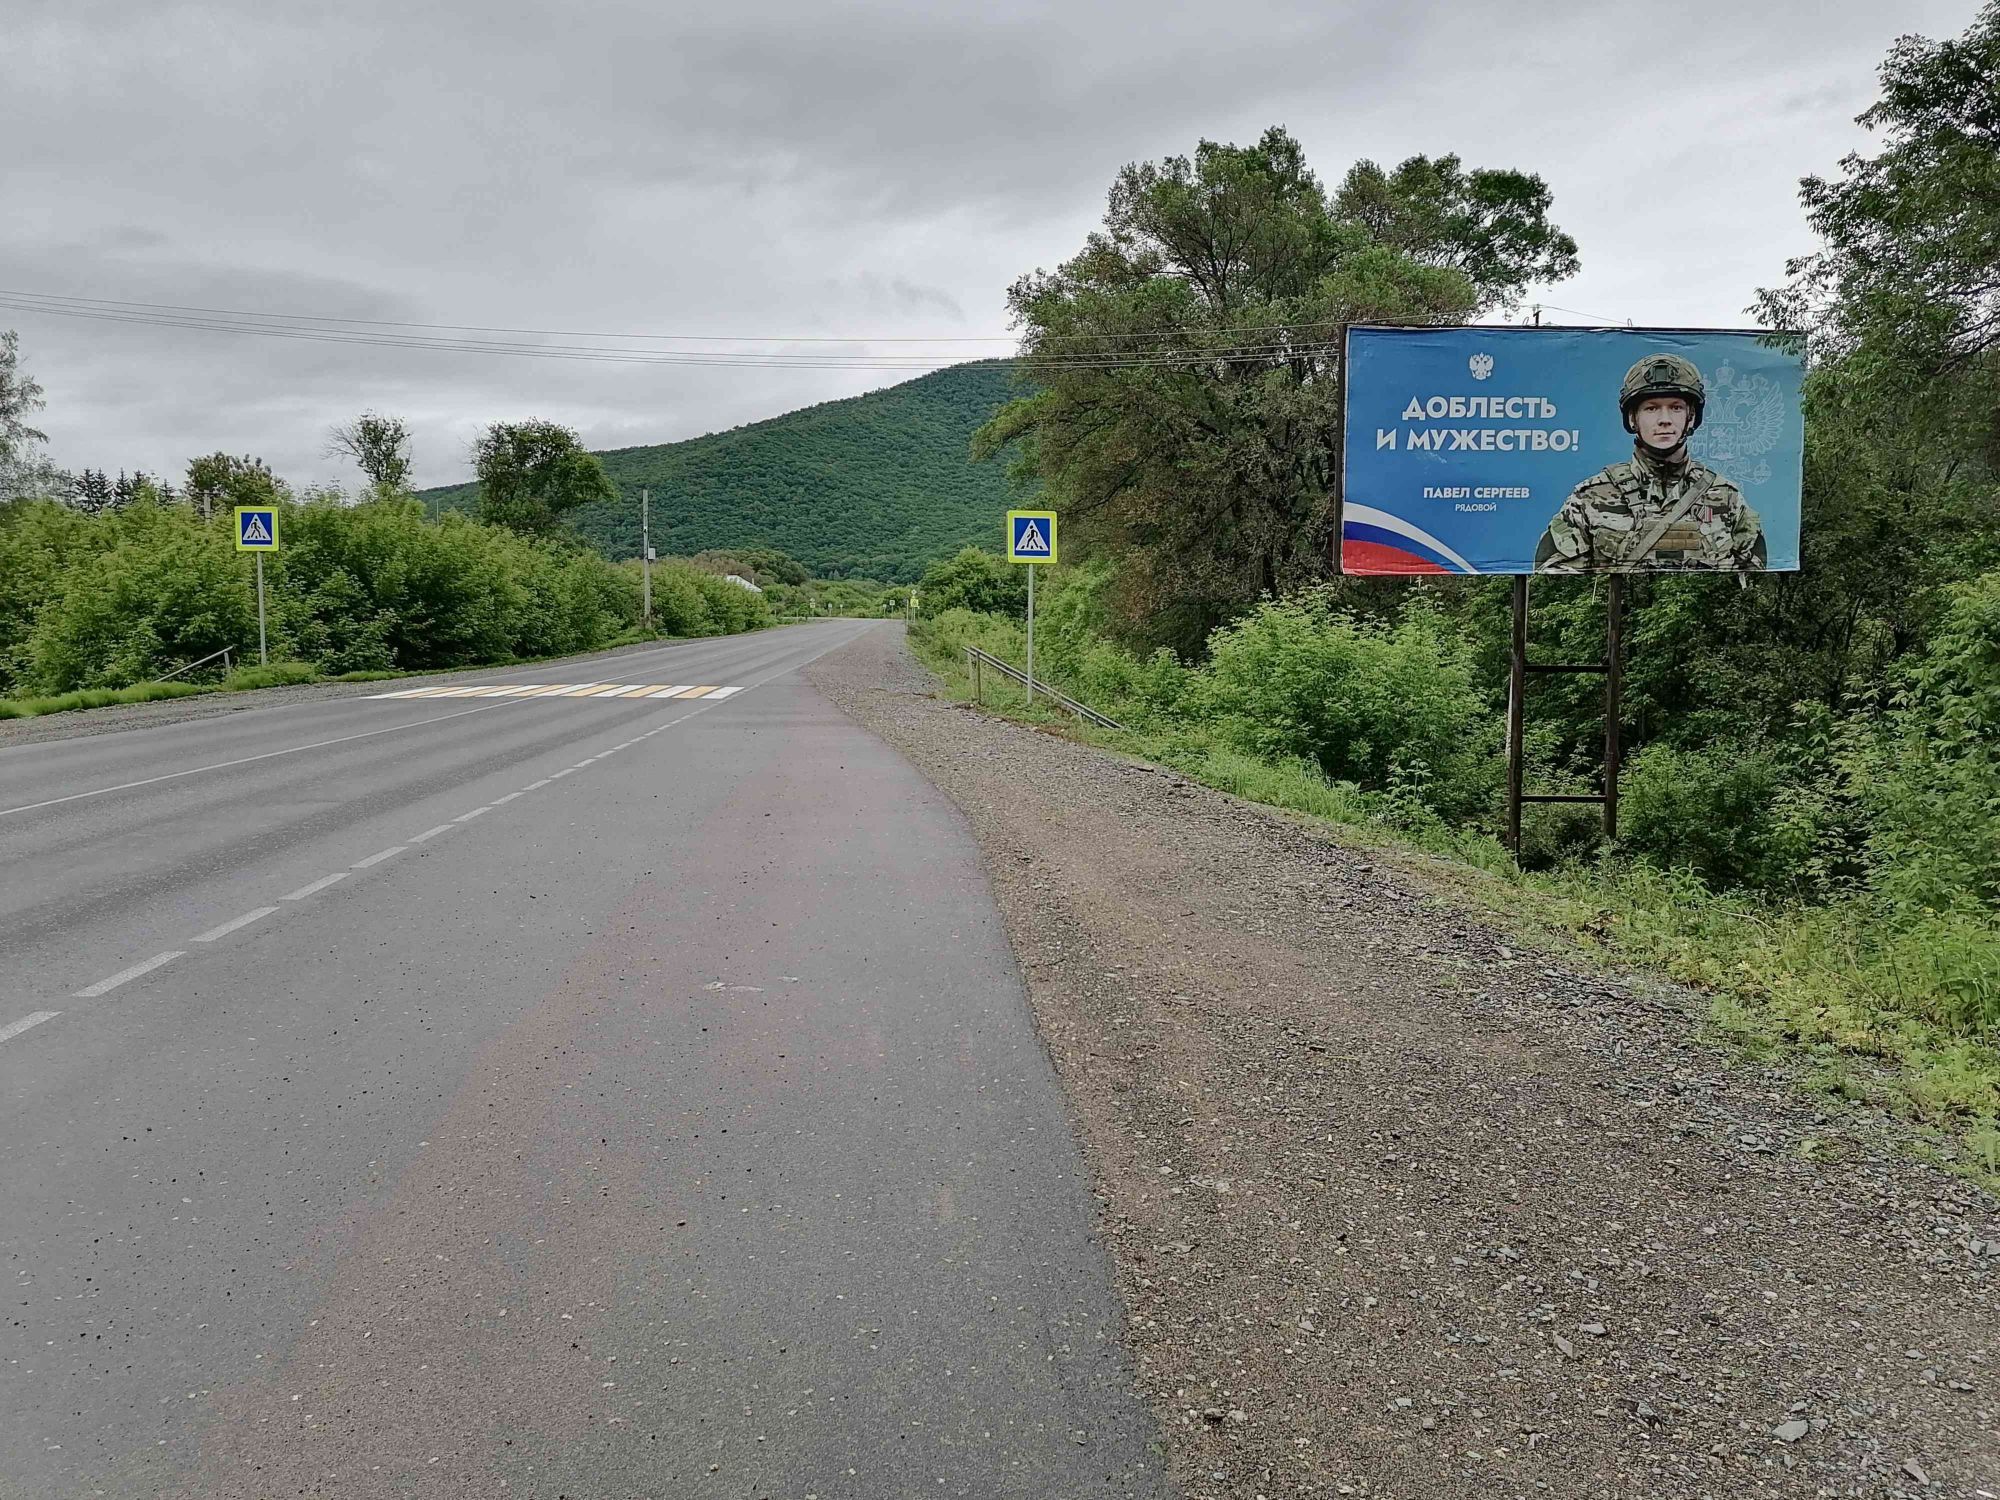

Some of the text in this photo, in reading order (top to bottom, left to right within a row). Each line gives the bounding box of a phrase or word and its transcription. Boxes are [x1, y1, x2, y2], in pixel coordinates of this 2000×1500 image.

[1402, 396, 1557, 421] ДОБЛЕСТЬ
[1376, 428, 1580, 452] И МУЖЕСТВО!
[1423, 487, 1530, 499] ПАВЕЛ СЕРГЕЕВ
[1455, 503, 1497, 513] РЯДОВОЙ
